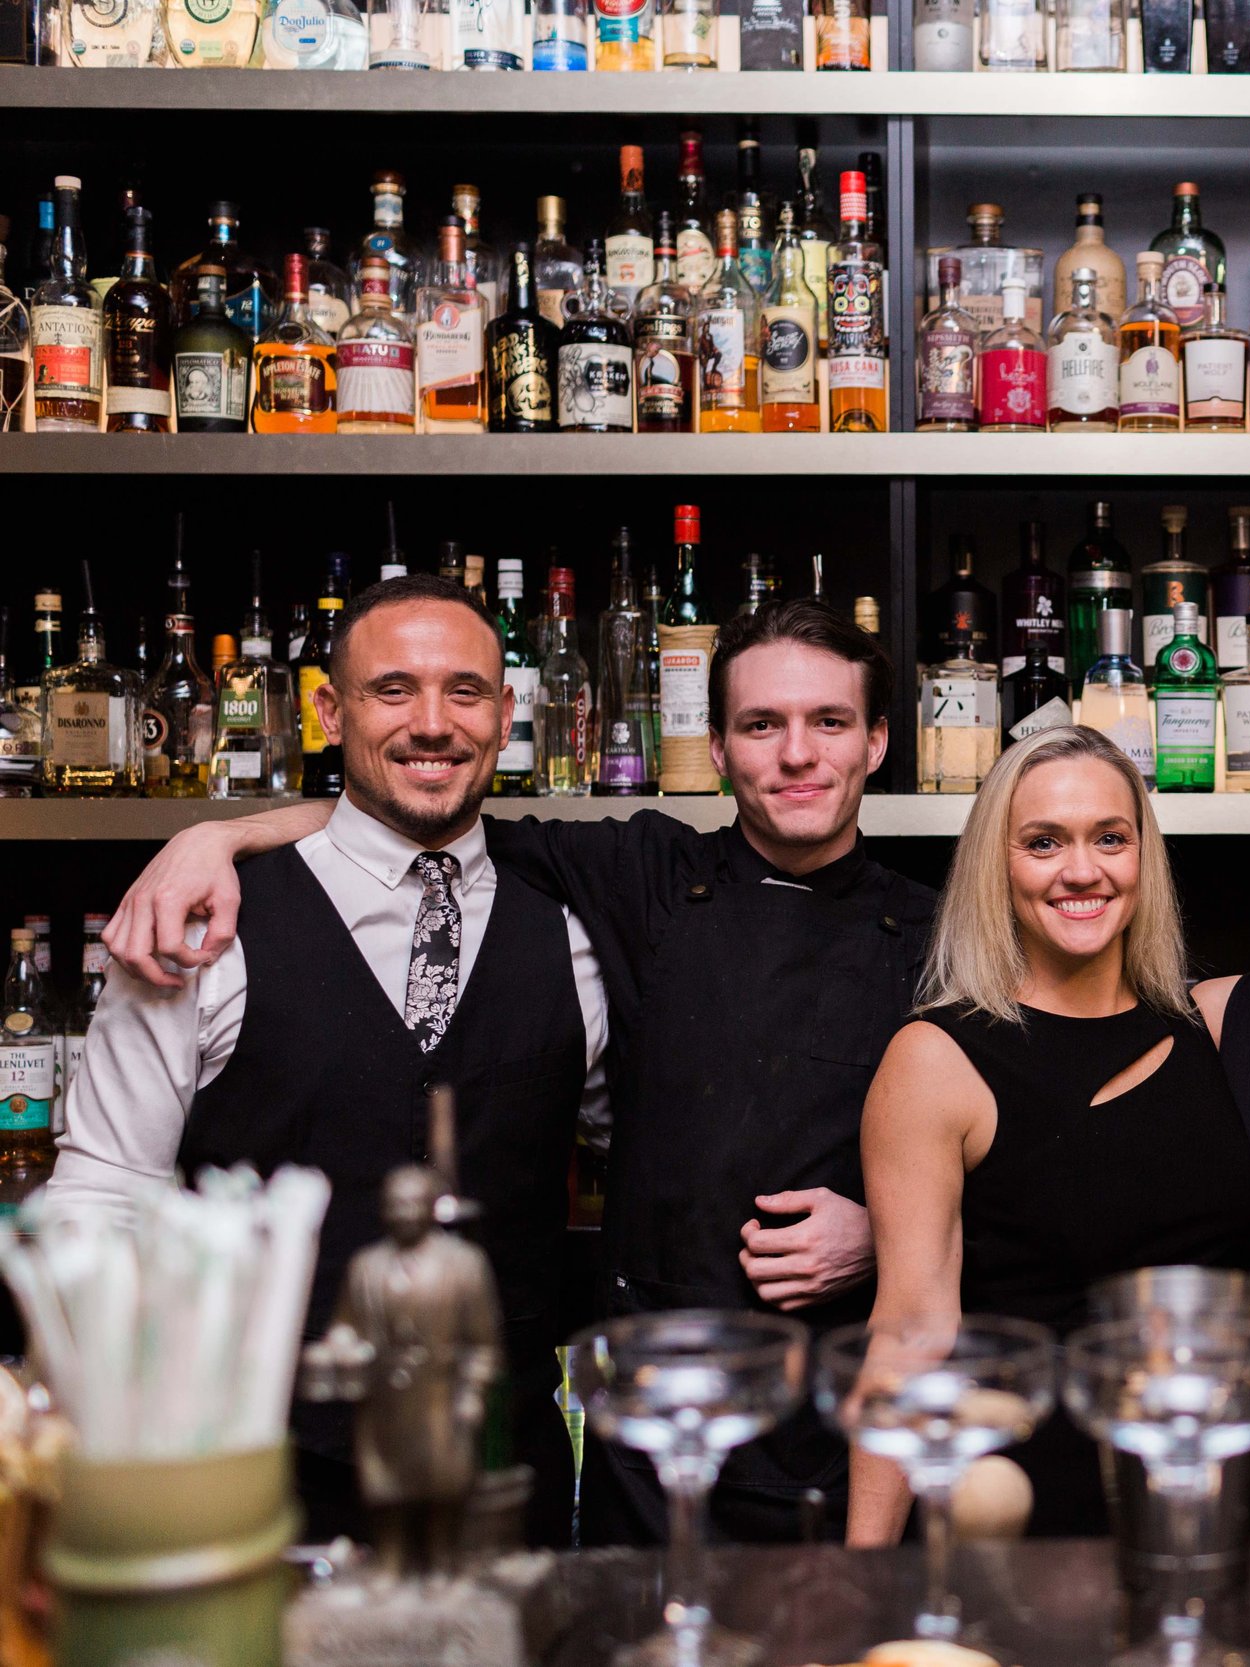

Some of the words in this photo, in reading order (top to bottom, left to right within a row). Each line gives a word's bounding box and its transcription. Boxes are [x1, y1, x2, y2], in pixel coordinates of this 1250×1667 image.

[263, 360, 296, 379] APPLETON
[588, 371, 627, 381] KRAKEN
[1062, 360, 1105, 379] HELLFIRE
[1016, 618, 1050, 628] WHITLEY
[224, 699, 258, 717] 1800
[57, 717, 106, 729] DISARONNO
[1162, 713, 1210, 728] Tanqueray
[575, 699, 586, 763] SOHO
[0, 1059, 46, 1069] LENLIVET
[11, 1071, 25, 1081] 12
